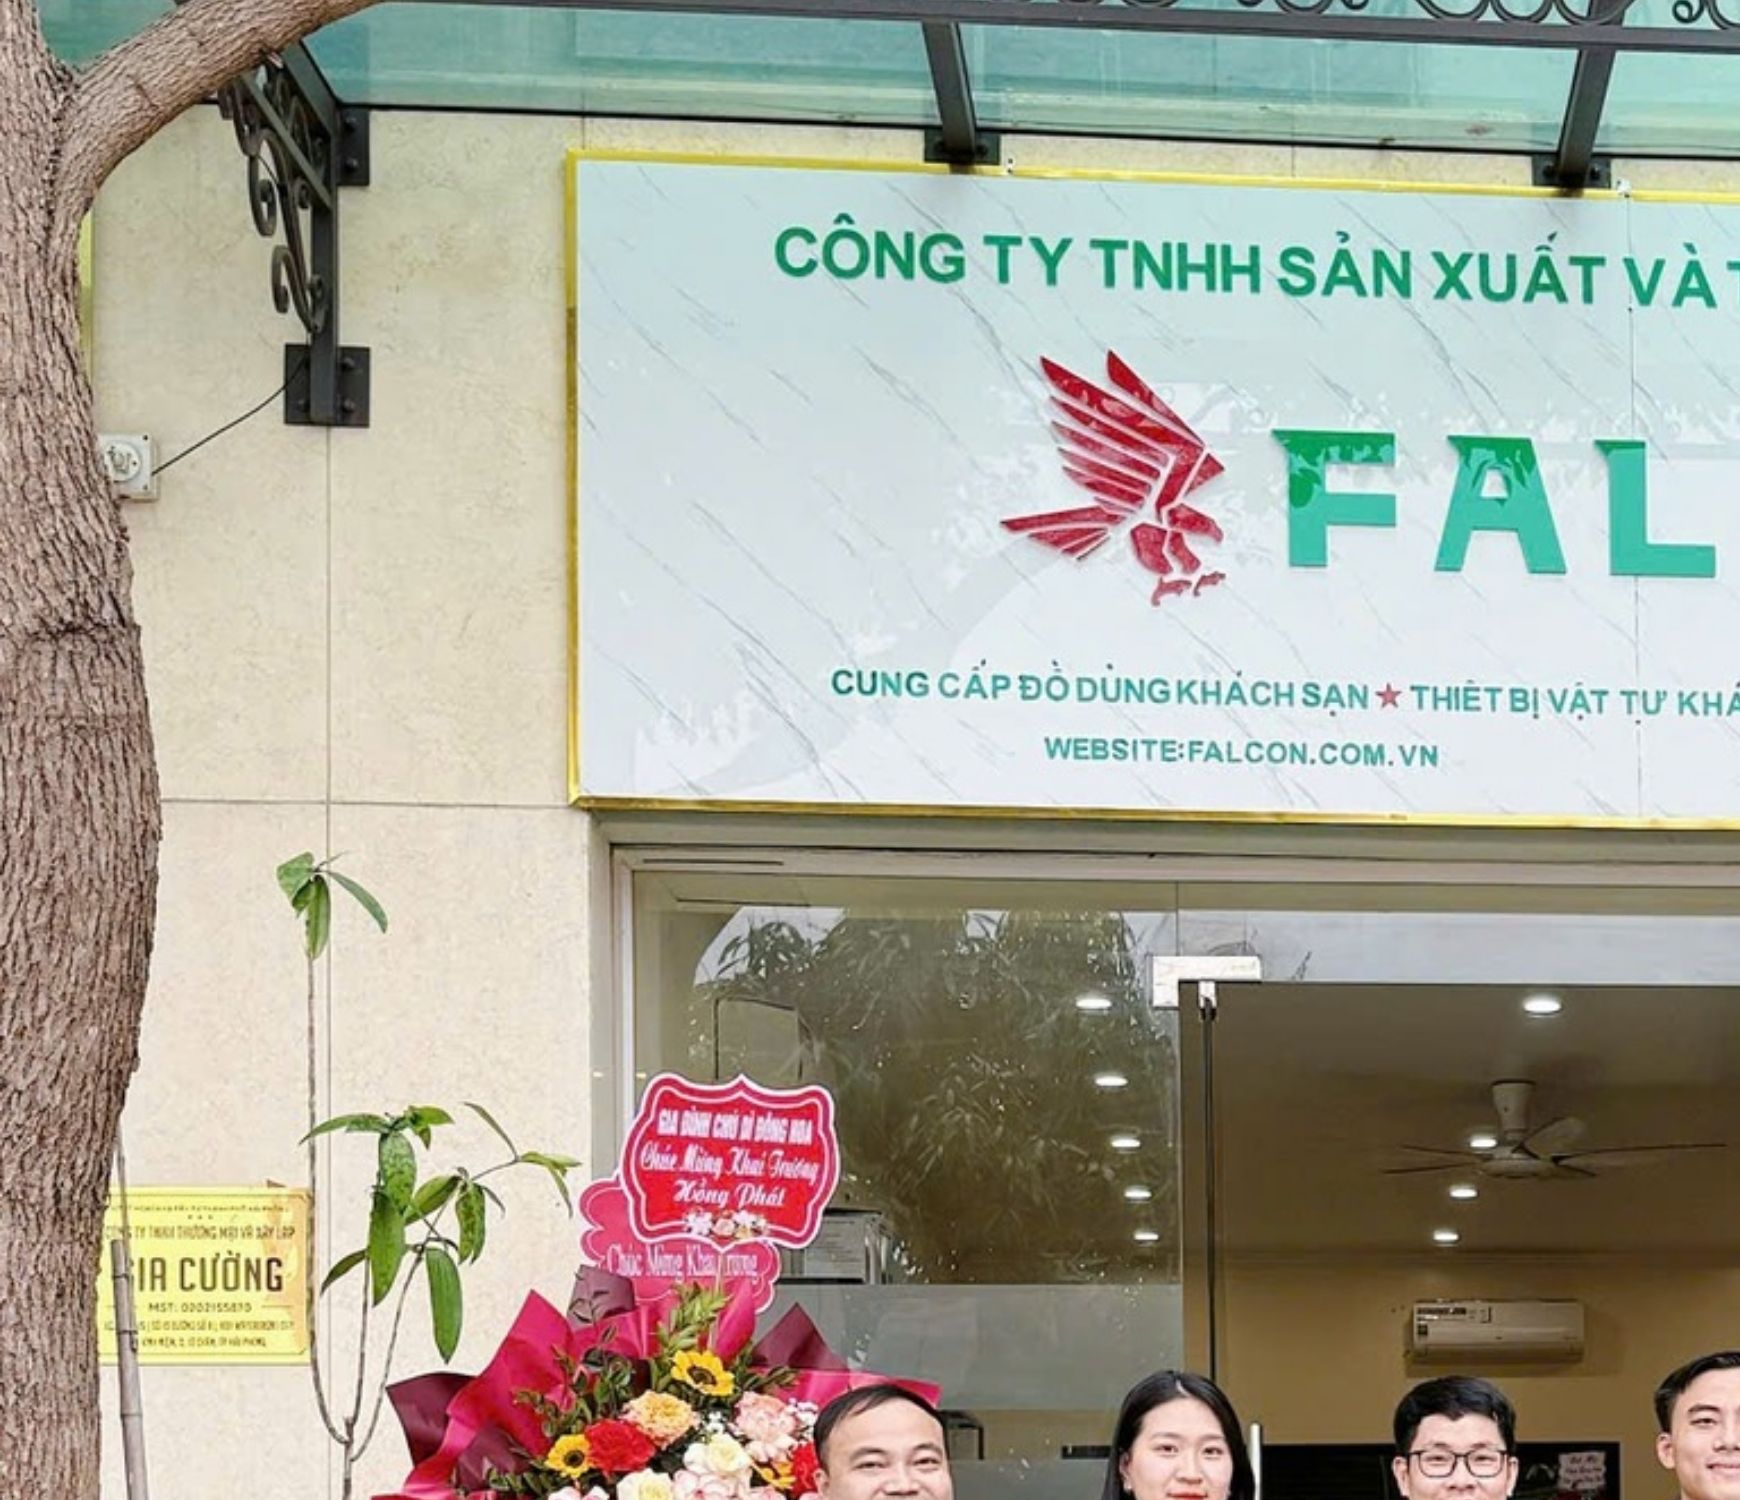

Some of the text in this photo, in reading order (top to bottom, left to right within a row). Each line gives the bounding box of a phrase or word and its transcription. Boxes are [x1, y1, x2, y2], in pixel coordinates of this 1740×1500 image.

[774, 212, 966, 284] CÔNG
[983, 234, 1074, 287] TY
[1089, 238, 1261, 294] TNHH
[1277, 230, 1413, 299] SẢN
[1431, 231, 1607, 305] XUẤT
[1622, 242, 1718, 309] VÀ
[830, 669, 931, 698] CUNG
[937, 657, 1012, 701] CẤP
[1076, 662, 1173, 704] DÙNG
[1178, 669, 1296, 708] KHÁCH
[1300, 681, 1370, 717] SẠN
[1509, 687, 1541, 719] BỊ
[129, 1250, 284, 1292] IA CƯỜNG
